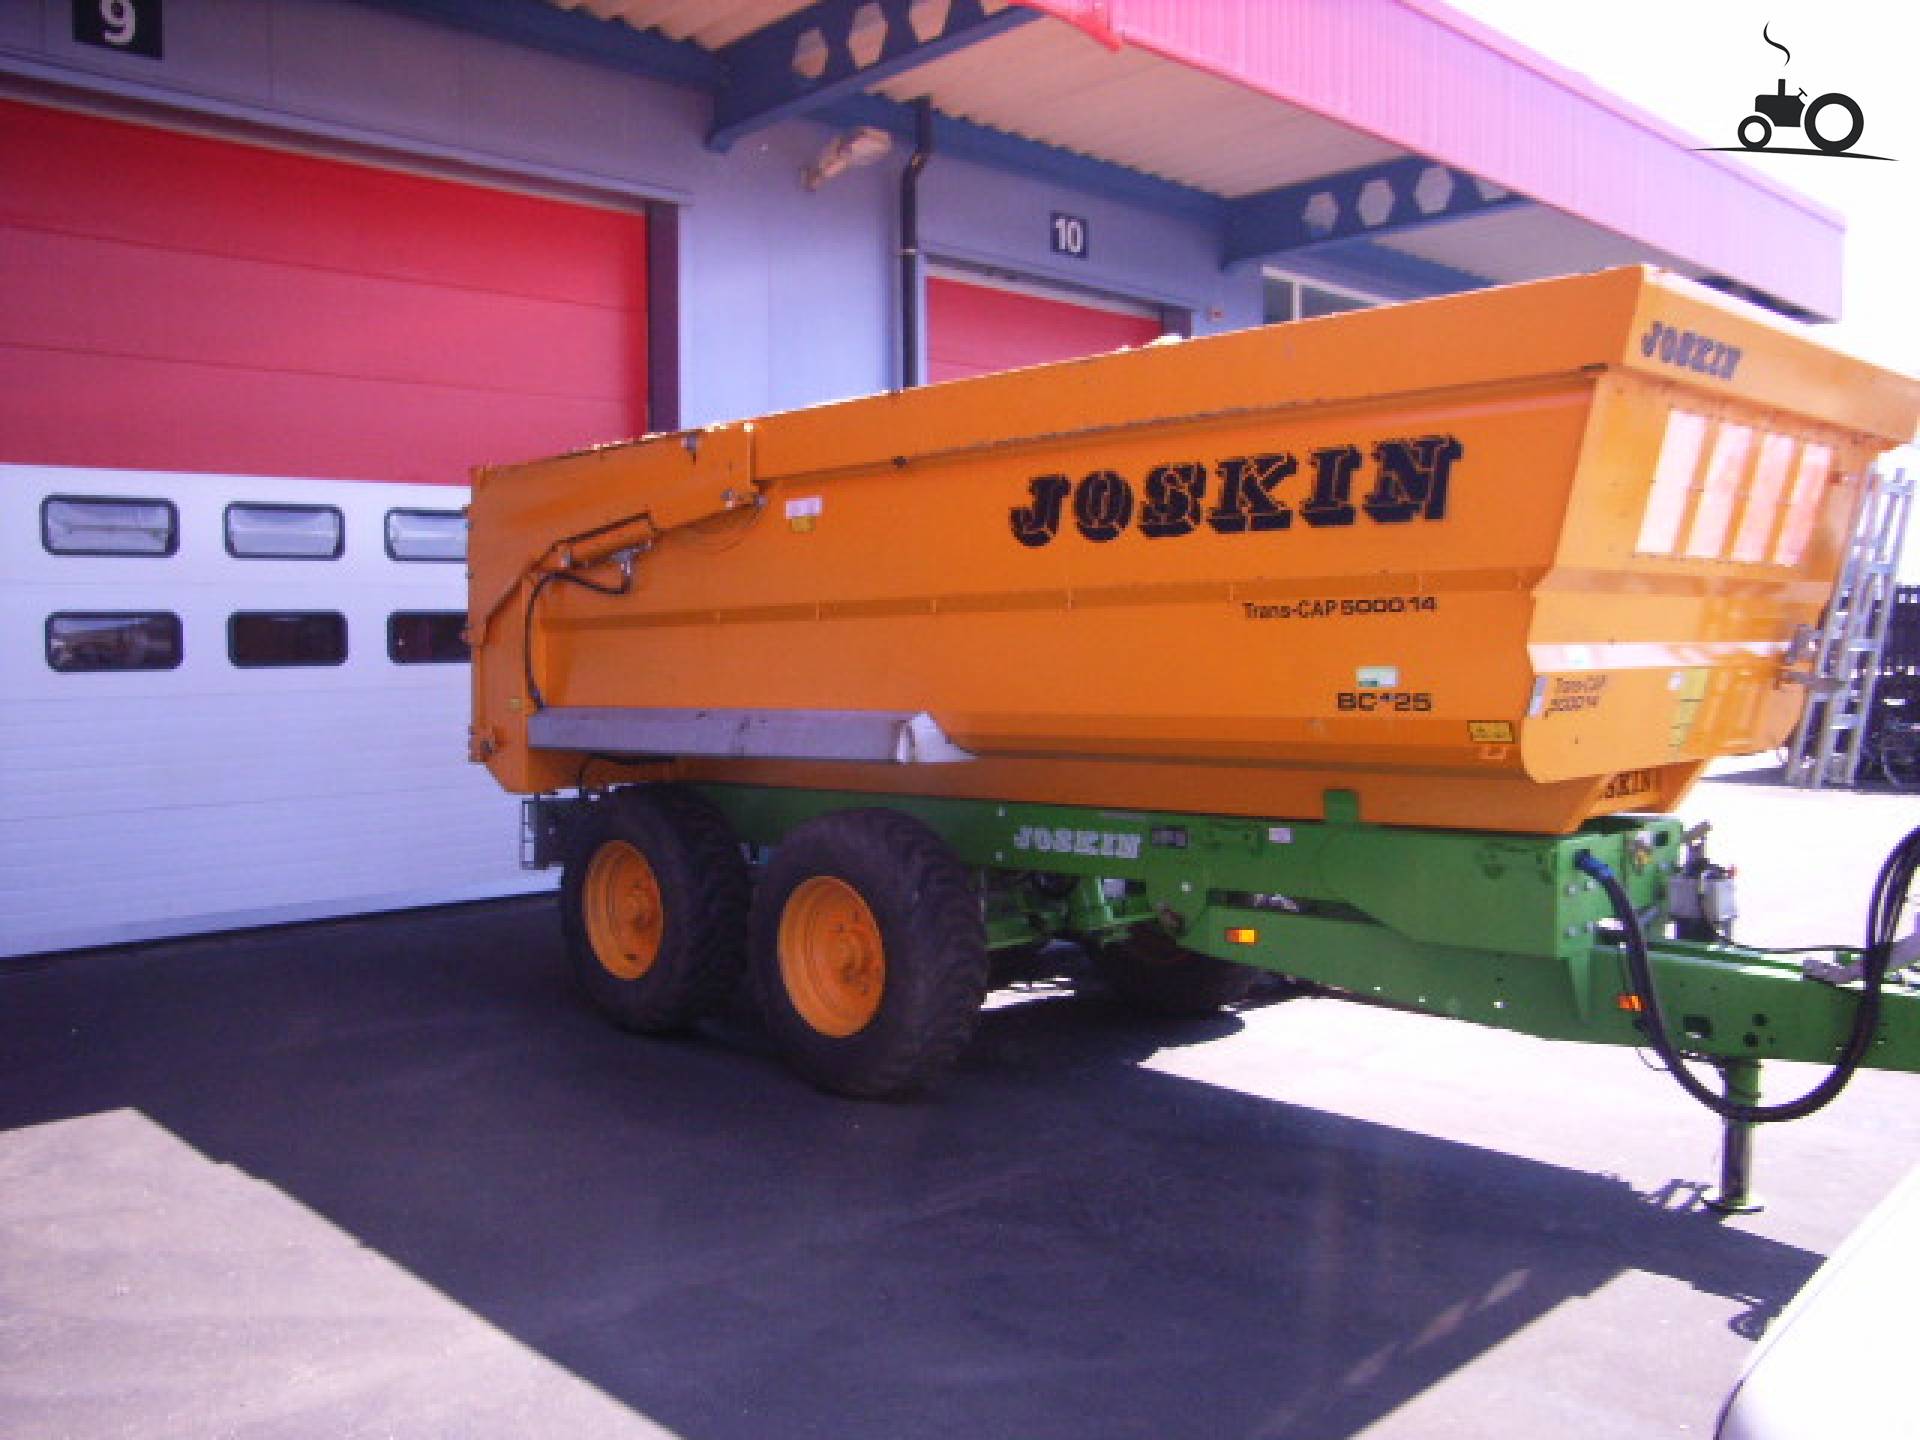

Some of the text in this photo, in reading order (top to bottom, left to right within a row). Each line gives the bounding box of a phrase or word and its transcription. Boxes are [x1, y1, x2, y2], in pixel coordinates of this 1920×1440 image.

[100, 0, 135, 45] 9
[1055, 218, 1084, 253] 10
[1641, 320, 1742, 381] JOSKIN
[1010, 434, 1464, 547] JOSKIN
[1012, 824, 1142, 859] JOSKIN
